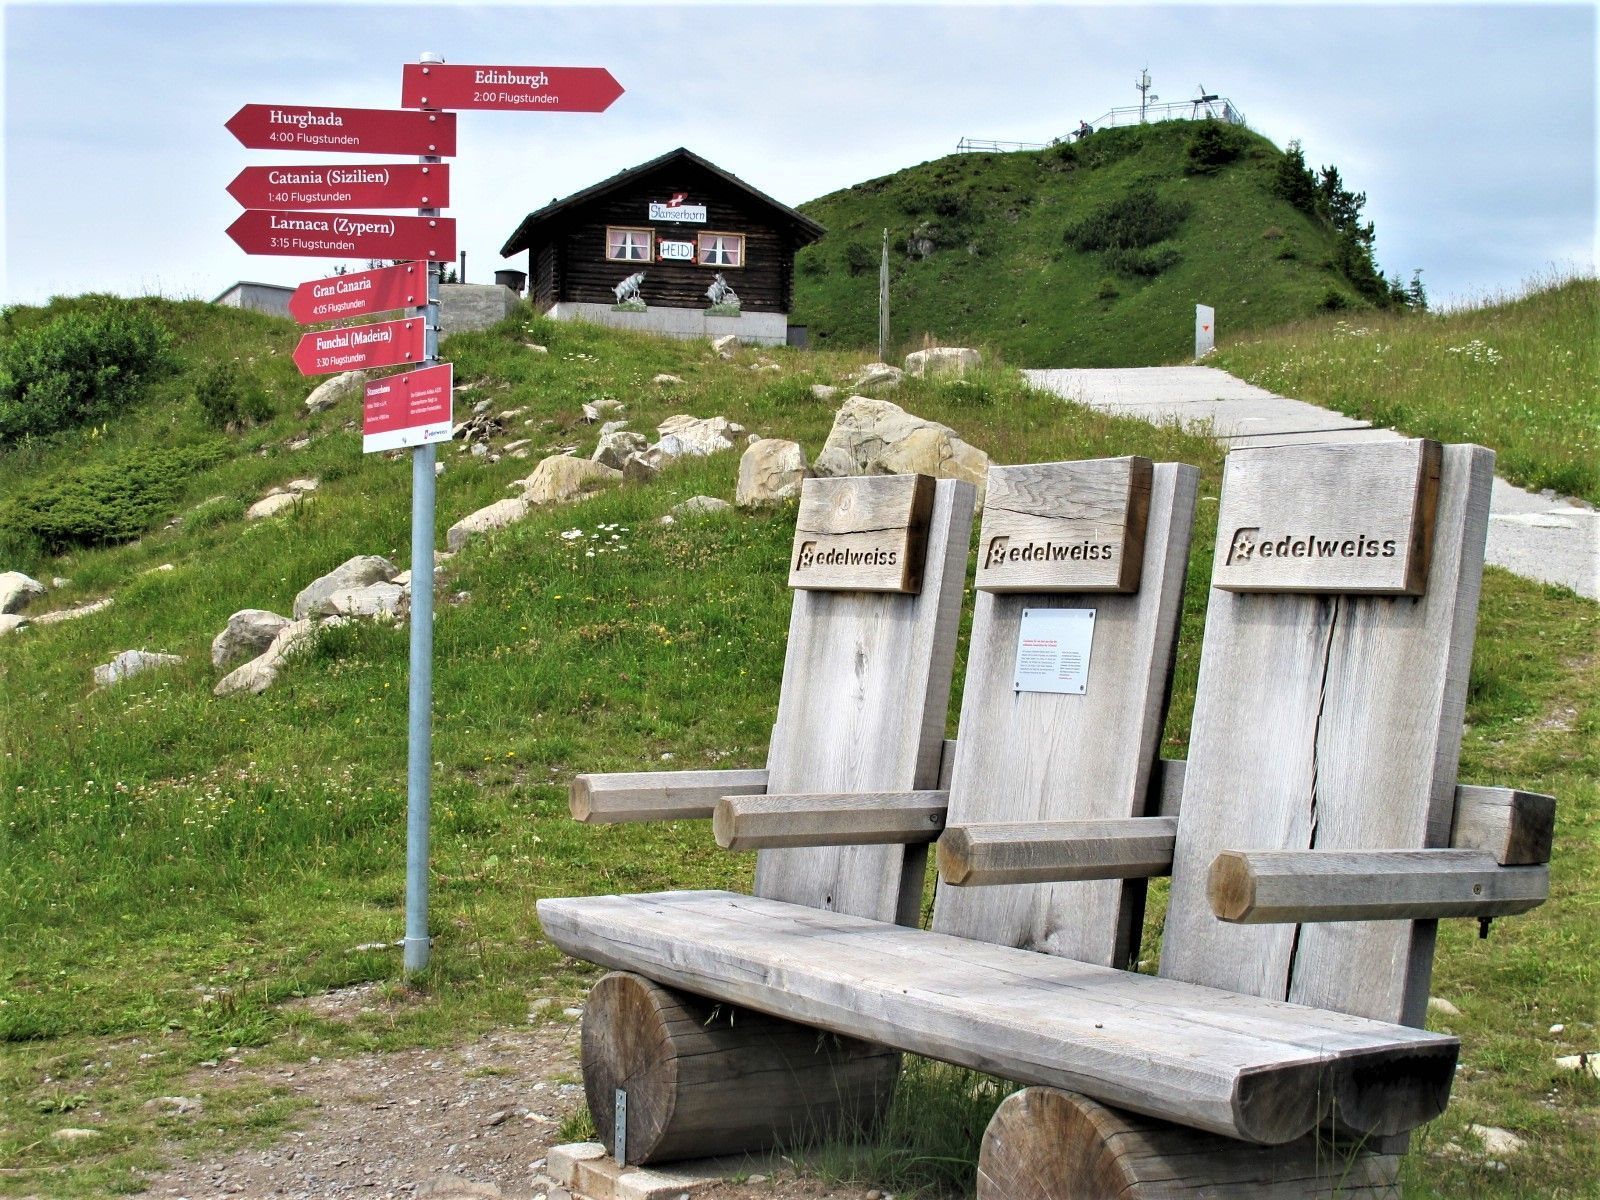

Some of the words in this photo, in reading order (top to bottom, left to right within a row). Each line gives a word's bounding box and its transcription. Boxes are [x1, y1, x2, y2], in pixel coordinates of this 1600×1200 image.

[475, 70, 549, 88] Edinburgh
[473, 92, 497, 102] 2:00
[499, 93, 559, 104] Flugstunden
[269, 110, 343, 128] Hurghada
[269, 132, 294, 142] 4:00
[297, 133, 360, 145] Flugstunden
[268, 171, 323, 185] Catania
[326, 169, 389, 186] (Sizilien)
[268, 192, 289, 202] 1:40
[291, 191, 351, 203] Flugstunden
[650, 204, 705, 220] Stanserhorn
[270, 215, 329, 231] Larnaca
[333, 217, 395, 236] (Zypern)
[270, 237, 290, 248] 3:15
[292, 238, 355, 250] Flugstunden
[661, 243, 693, 257] HEIDI
[313, 284, 336, 298] Gran
[337, 277, 372, 294] Canaria
[313, 304, 327, 315] 4:05
[328, 299, 366, 313] Flugstunden
[316, 333, 349, 350] Funchal
[351, 326, 392, 348] (Madeira)
[316, 357, 330, 367] 3:30
[330, 352, 366, 367] Flugstunden
[1009, 541, 1113, 563] edelweiss
[1259, 534, 1397, 559] edelweiss
[816, 545, 898, 567] edelweiss
